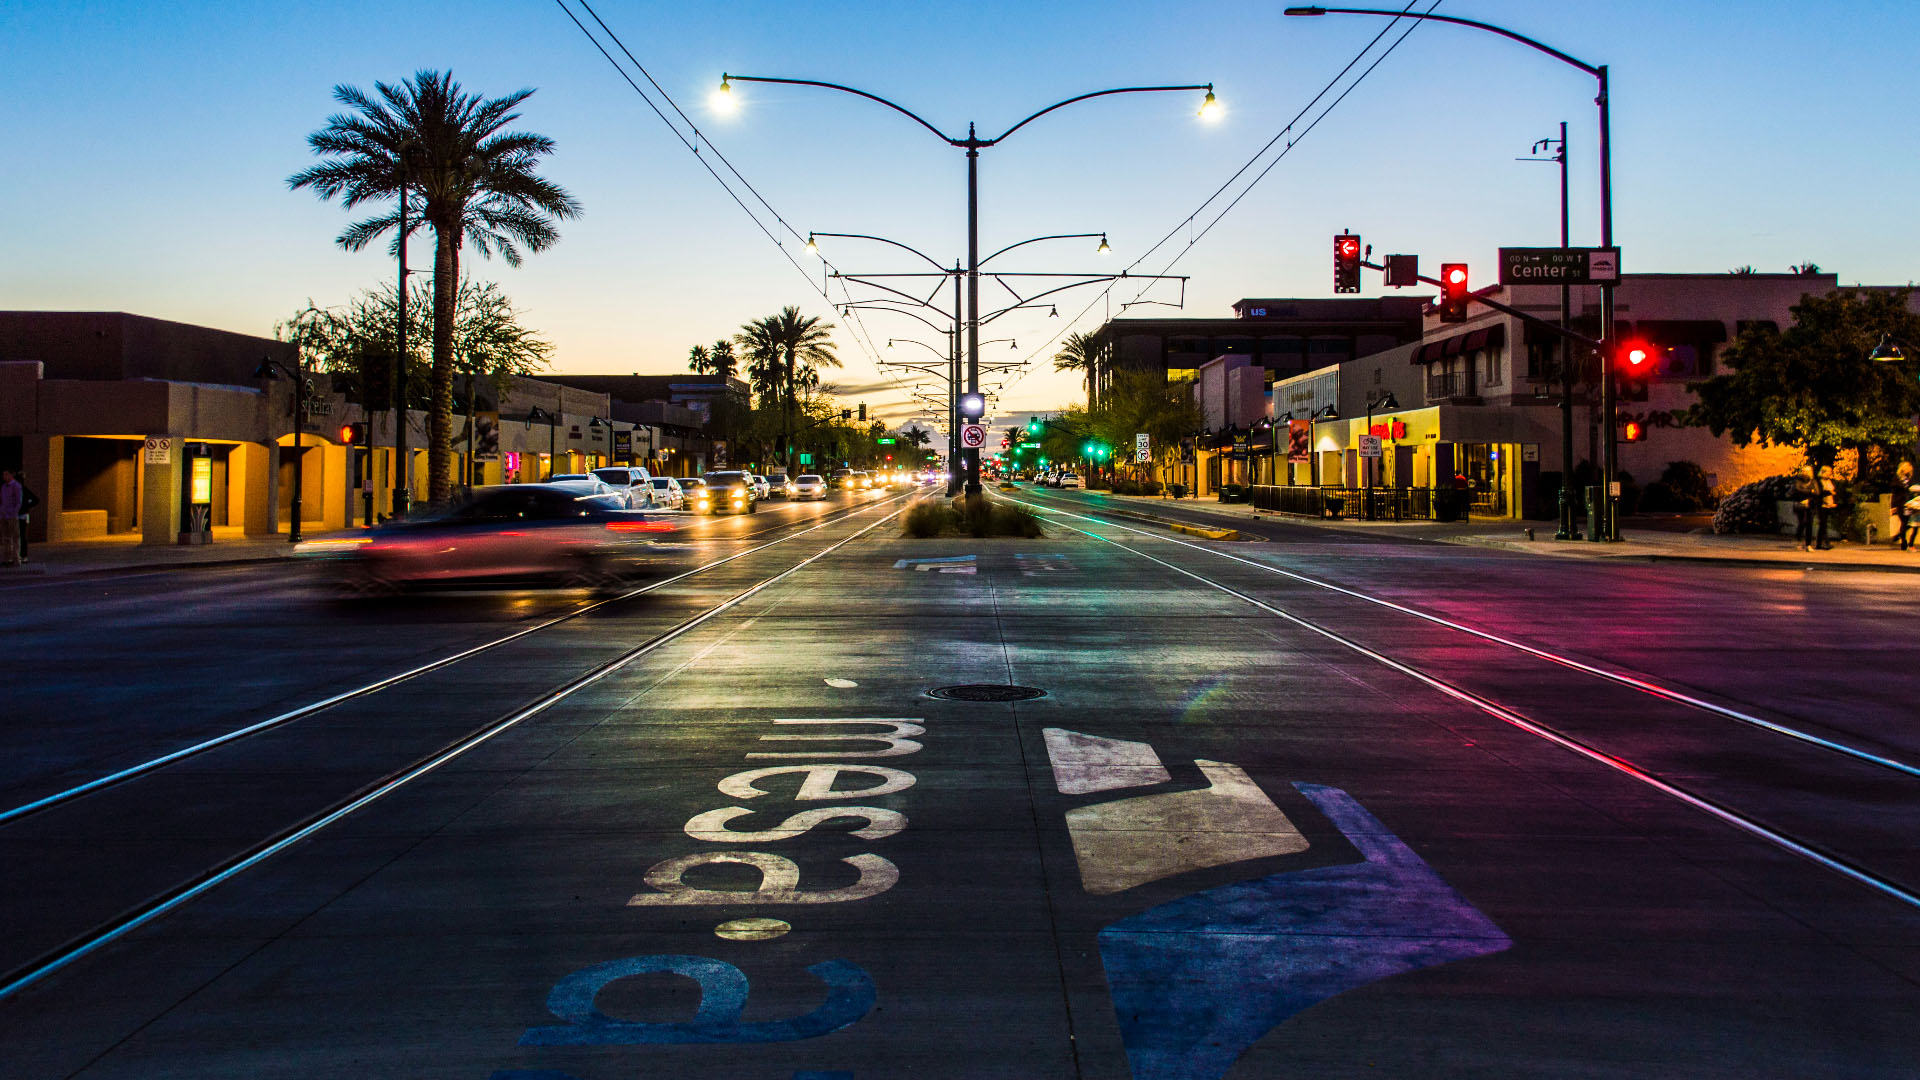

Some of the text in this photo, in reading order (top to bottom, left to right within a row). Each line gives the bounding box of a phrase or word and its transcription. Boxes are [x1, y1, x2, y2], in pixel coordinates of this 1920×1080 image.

[1523, 255, 1529, 263] N
[1552, 255, 1574, 263] 00 W
[1512, 264, 1568, 277] Center
[626, 717, 926, 906] mesa
